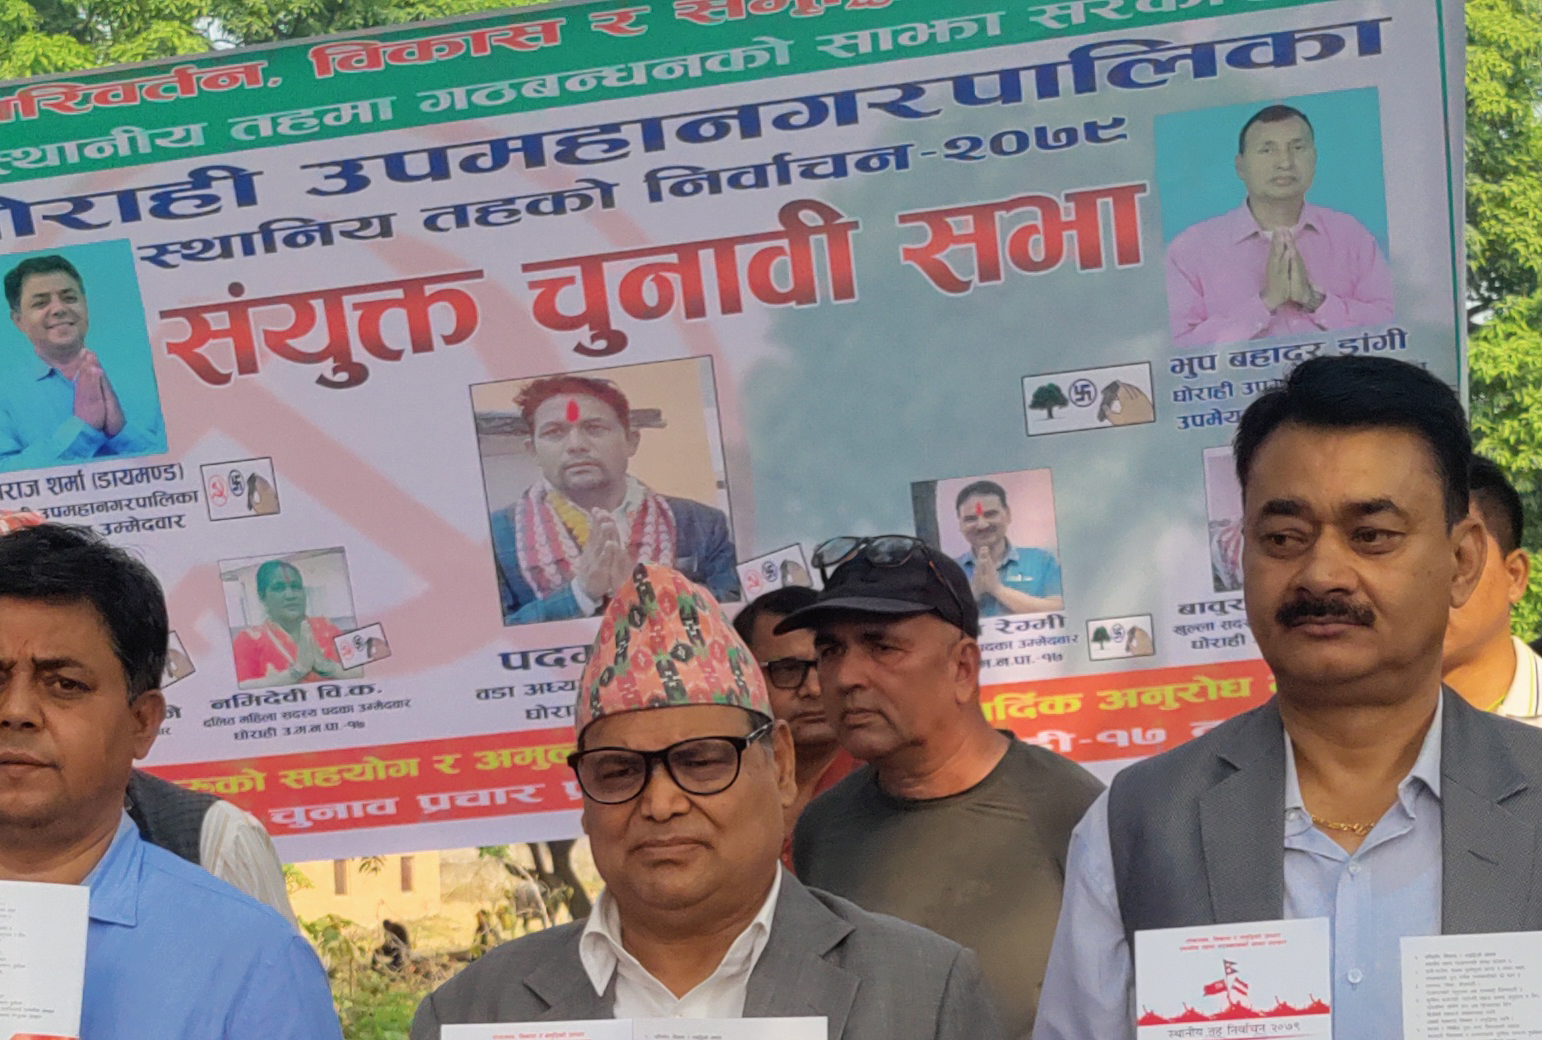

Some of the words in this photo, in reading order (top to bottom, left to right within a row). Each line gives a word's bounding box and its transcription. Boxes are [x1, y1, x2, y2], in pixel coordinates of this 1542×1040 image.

[310, 19, 566, 82] विकास
[591, 8, 650, 38] र
[228, 95, 397, 142] तहमा
[420, 37, 794, 114] गठबन्धनको
[815, 11, 1005, 58] साझा
[299, 17, 1393, 197] उपमहानगरपालिका
[137, 212, 397, 269] स्थानिय
[420, 178, 620, 233] तहको
[158, 269, 485, 390] संयुक्त
[521, 198, 861, 358] चुनावी
[897, 182, 1149, 296] सभा
[1173, 381, 1234, 403] घोराही
[47, 469, 87, 496] शर्मा
[475, 686, 515, 700] वडा
[1096, 675, 1252, 710] अनुरोध
[525, 704, 574, 720] घोरा
[279, 757, 421, 788] सहयोग
[433, 753, 461, 774] र
[269, 796, 399, 828] चुनाव
[417, 783, 546, 814] प्रचार
[1270, 1021, 1300, 1032] २०७९
